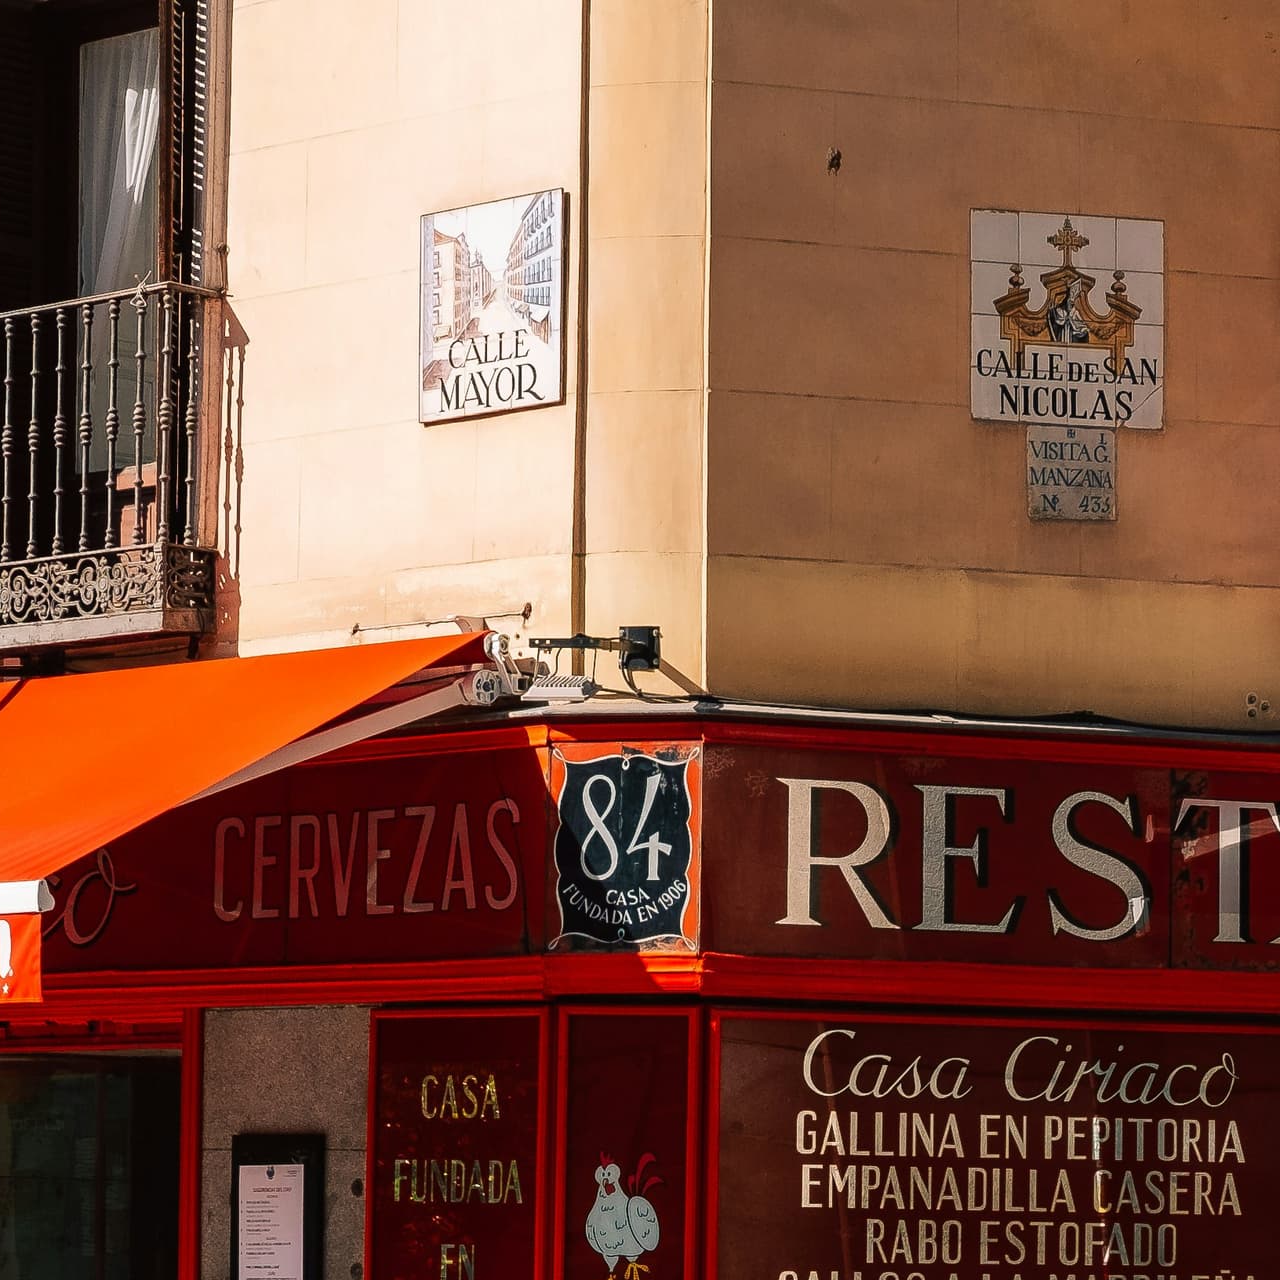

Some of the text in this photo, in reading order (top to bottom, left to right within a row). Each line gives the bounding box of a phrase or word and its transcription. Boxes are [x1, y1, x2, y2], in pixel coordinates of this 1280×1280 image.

[448, 328, 530, 369] CALLE
[976, 349, 1158, 387] CALLE DE SAN
[438, 363, 546, 413] MAYOR
[999, 383, 1133, 421] NICOLAS
[1028, 440, 1092, 463] VISITA
[1029, 466, 1114, 490] MANZANA
[580, 772, 673, 881] 84
[213, 798, 521, 922] CERVEZAS
[562, 879, 687, 926] FUNDADA EN 1906
[605, 886, 651, 907] CASA
[802, 1028, 1240, 1108] Casa Ciriaco
[420, 1073, 501, 1120] CASA
[796, 1109, 1246, 1164] GALLINA EN PEPITORIA
[393, 1159, 523, 1205] FUNDADA
[800, 1163, 1243, 1216] EMPANADILLA CASERA
[865, 1218, 1177, 1268] RABO ESTOFADO
